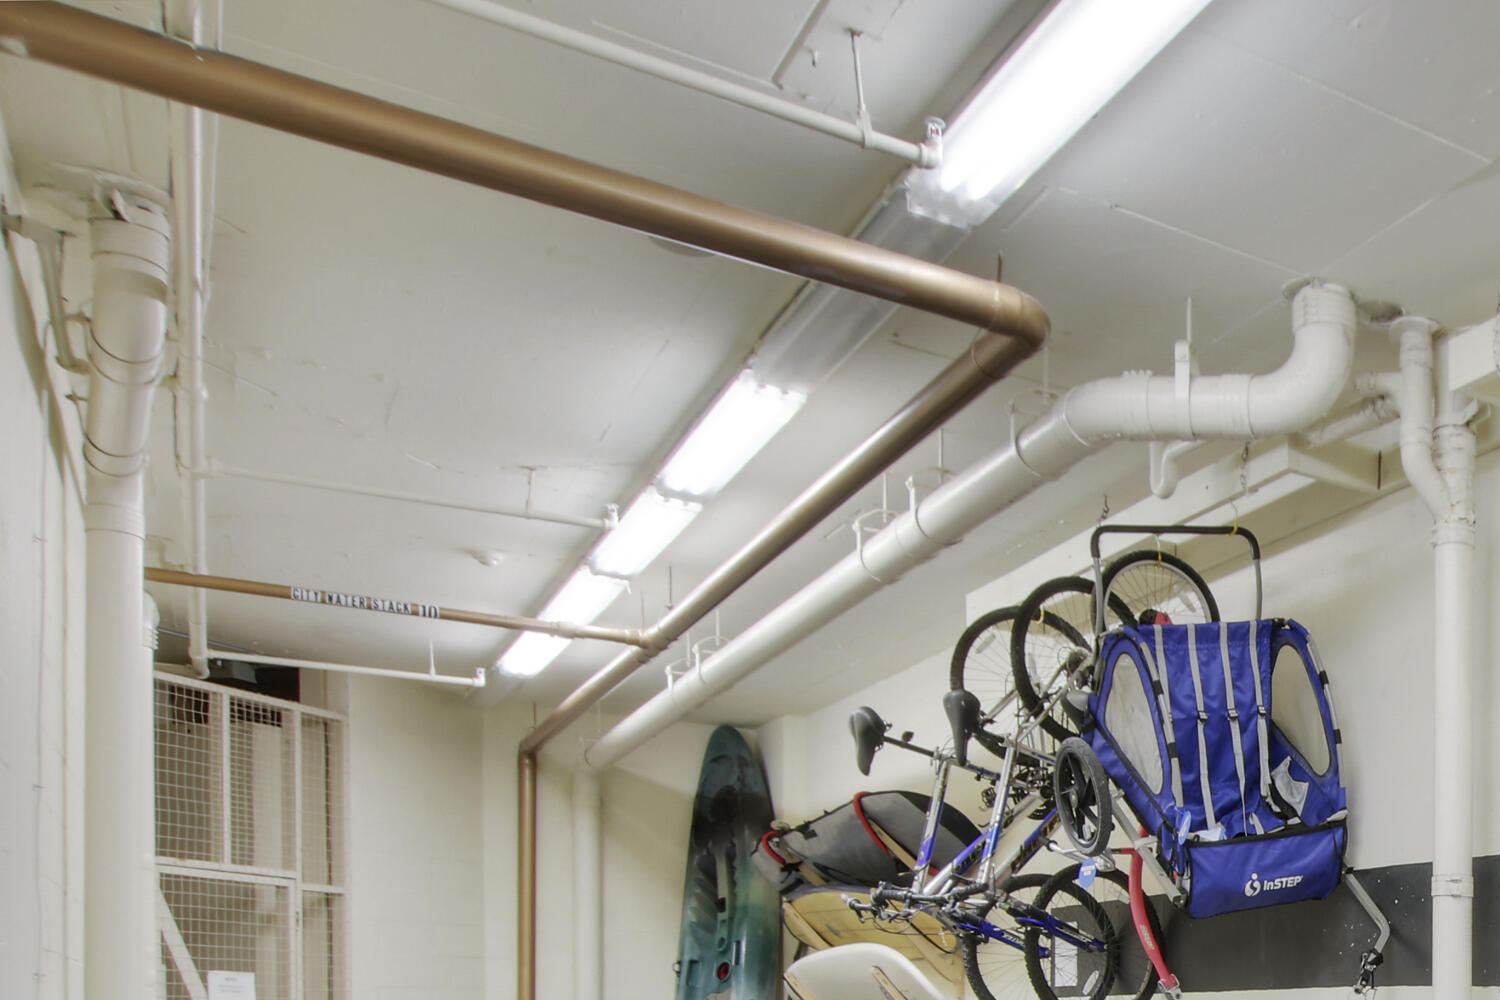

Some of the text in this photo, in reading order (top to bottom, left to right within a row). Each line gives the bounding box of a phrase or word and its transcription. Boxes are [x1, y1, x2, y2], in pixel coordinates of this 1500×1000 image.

[292, 587, 438, 619] CITY WATER STACK 10
[1263, 875, 1303, 891] InSTEP
